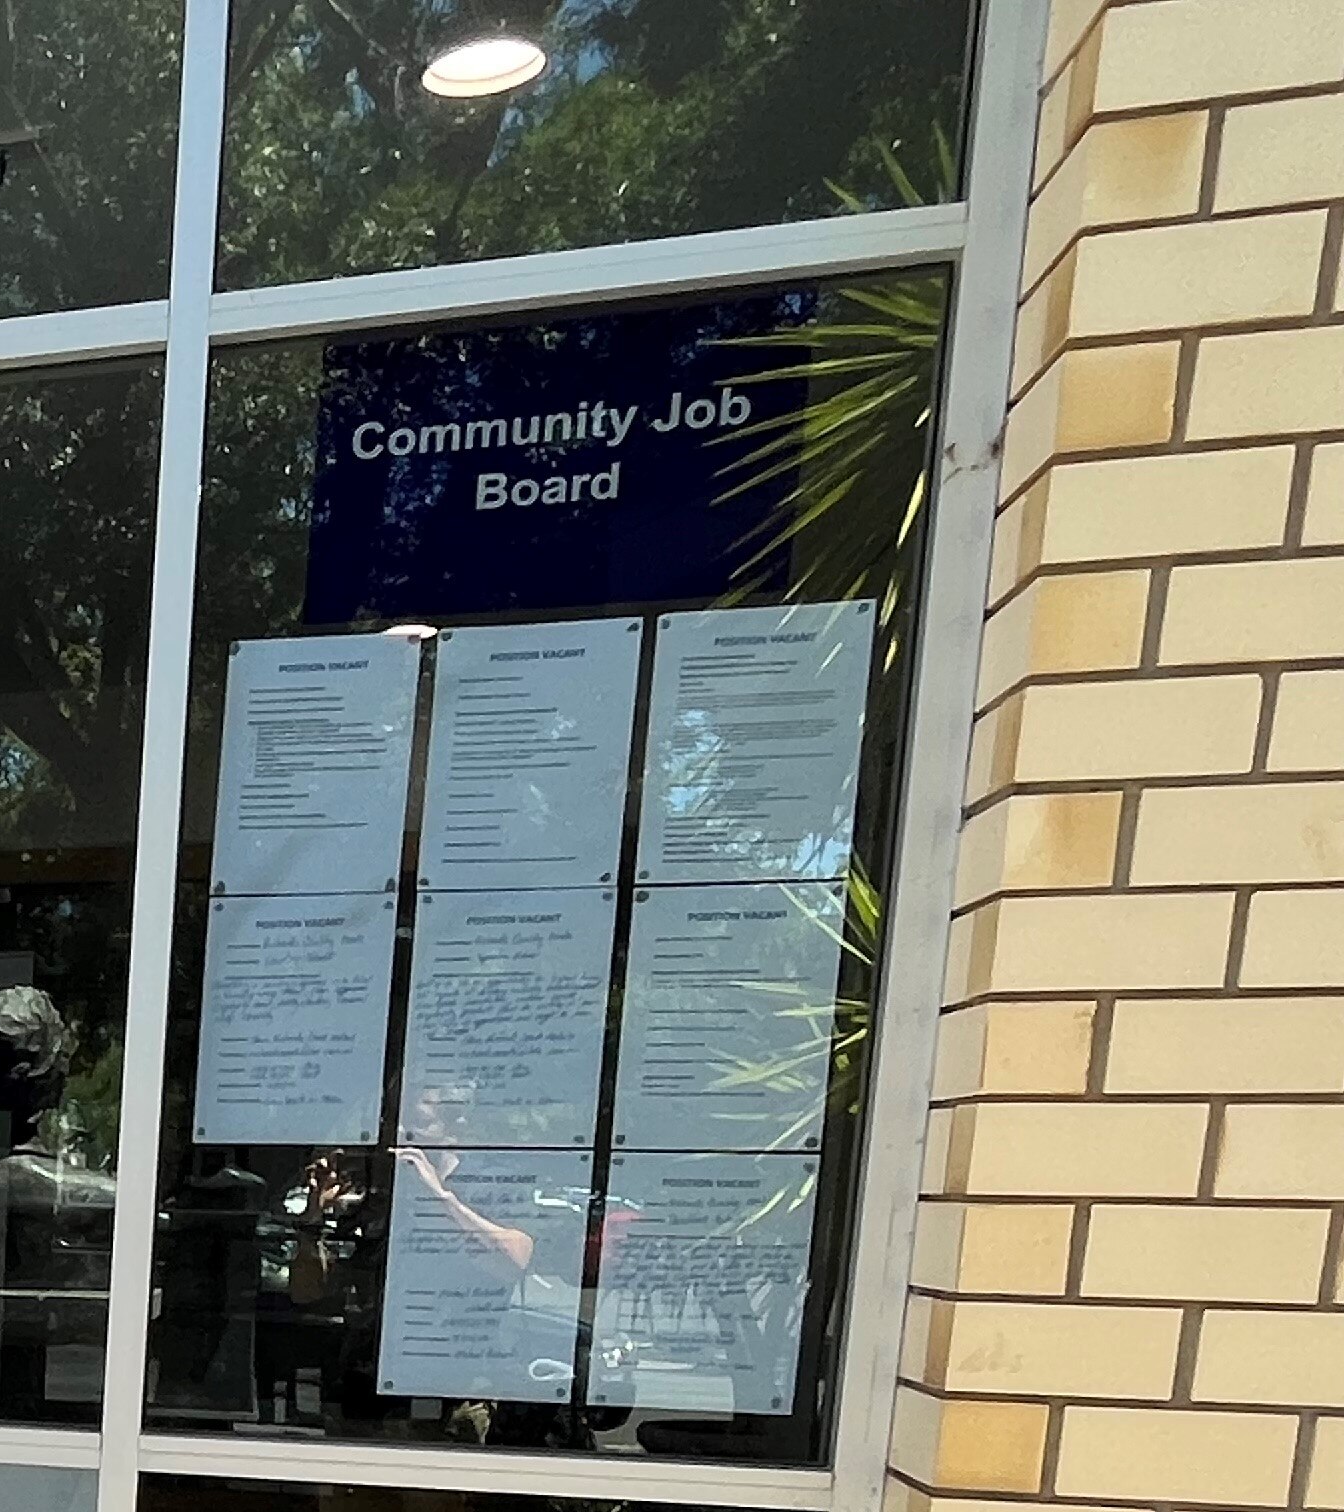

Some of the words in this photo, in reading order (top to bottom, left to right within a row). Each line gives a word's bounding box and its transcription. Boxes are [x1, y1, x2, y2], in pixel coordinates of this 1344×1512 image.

[352, 401, 637, 460] Community
[651, 387, 752, 432] Job
[475, 463, 621, 511] Board
